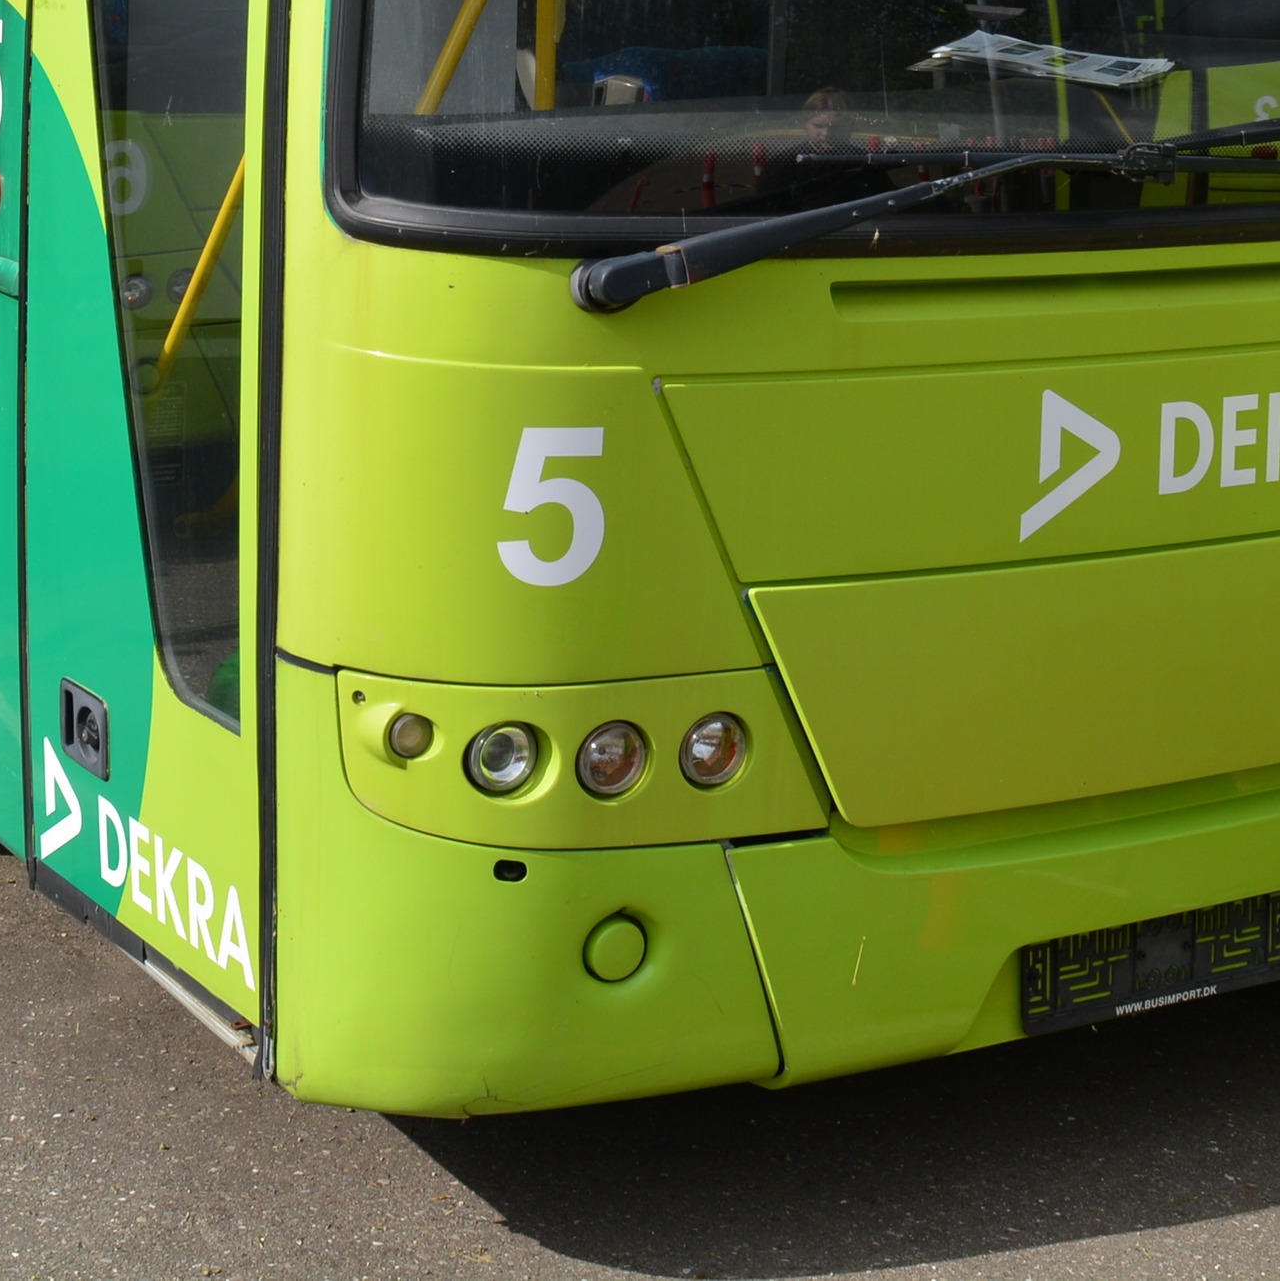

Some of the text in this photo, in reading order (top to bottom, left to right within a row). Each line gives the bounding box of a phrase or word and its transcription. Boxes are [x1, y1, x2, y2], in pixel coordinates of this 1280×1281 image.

[496, 426, 605, 587] 5
[97, 794, 256, 992] DEKRA
[1115, 984, 1218, 1016] WWW.BUSIMPORT.DK
